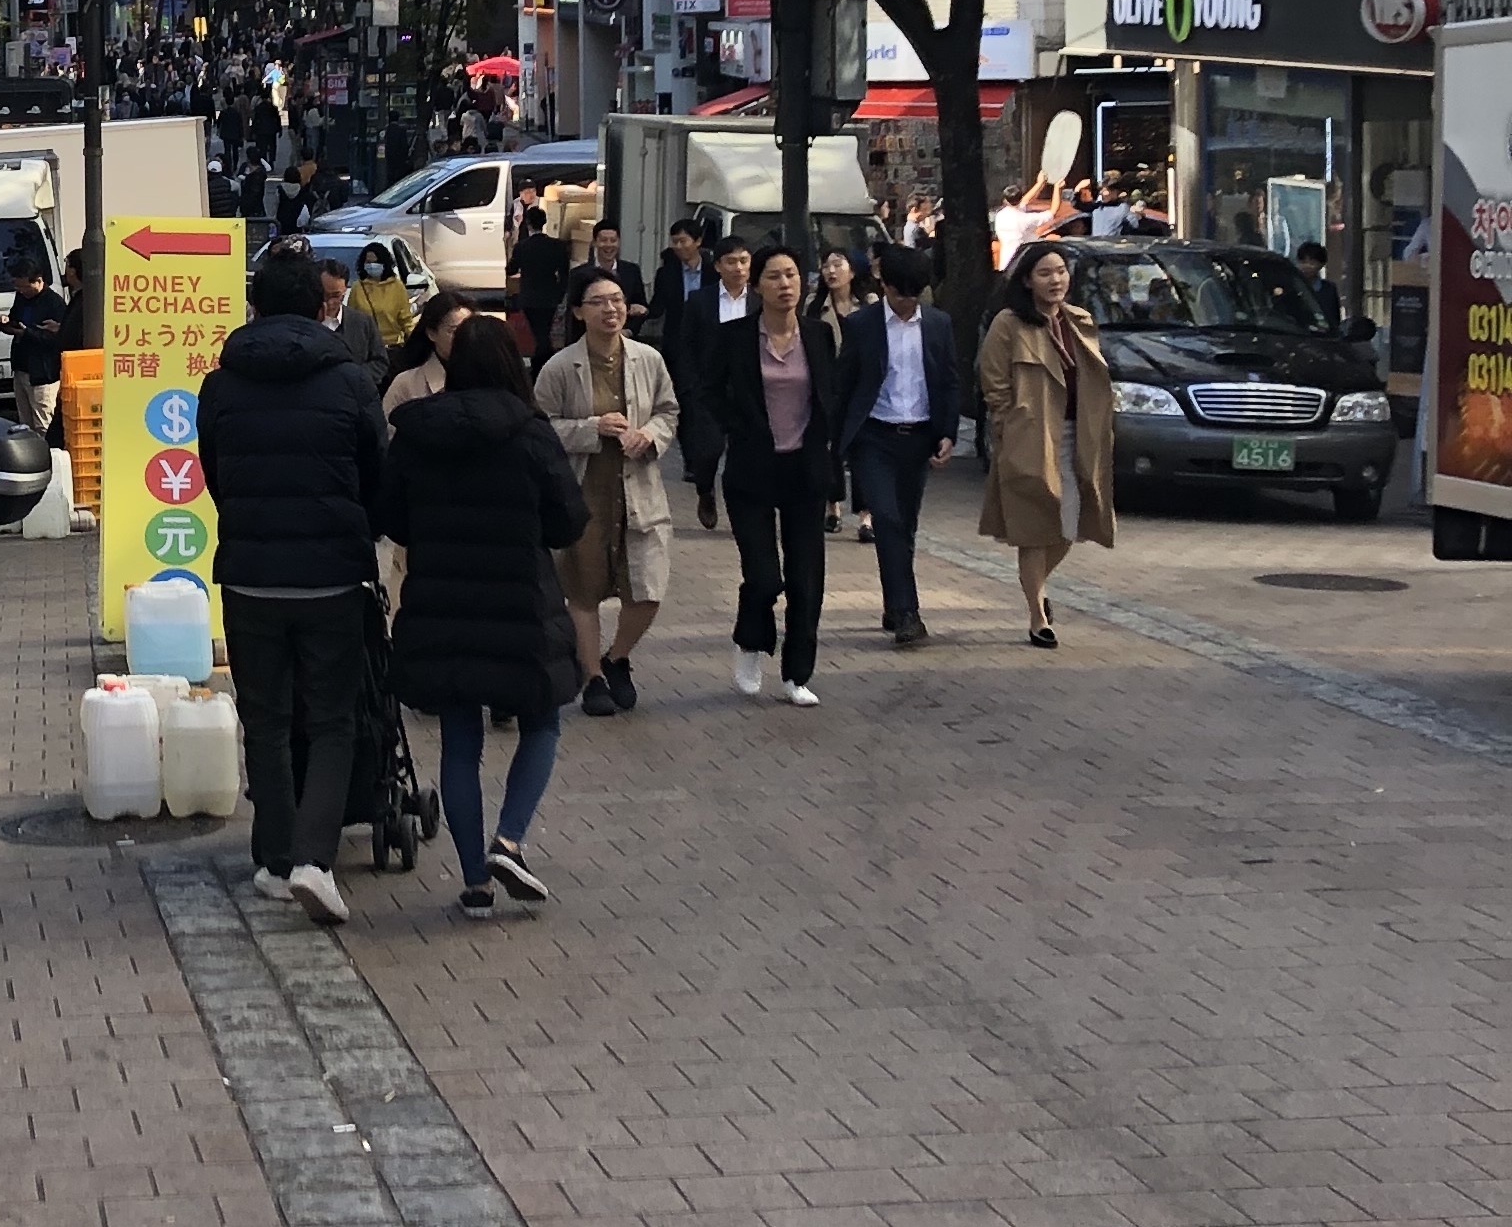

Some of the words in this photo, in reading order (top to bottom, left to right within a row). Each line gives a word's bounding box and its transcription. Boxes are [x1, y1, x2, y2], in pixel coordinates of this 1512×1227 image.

[676, 0, 697, 10] FIX
[112, 274, 203, 293] MONEY
[112, 294, 232, 315] EXCHAGE
[111, 352, 161, 379] 両替
[1234, 448, 1291, 468] 4516
[155, 515, 198, 557] 元
